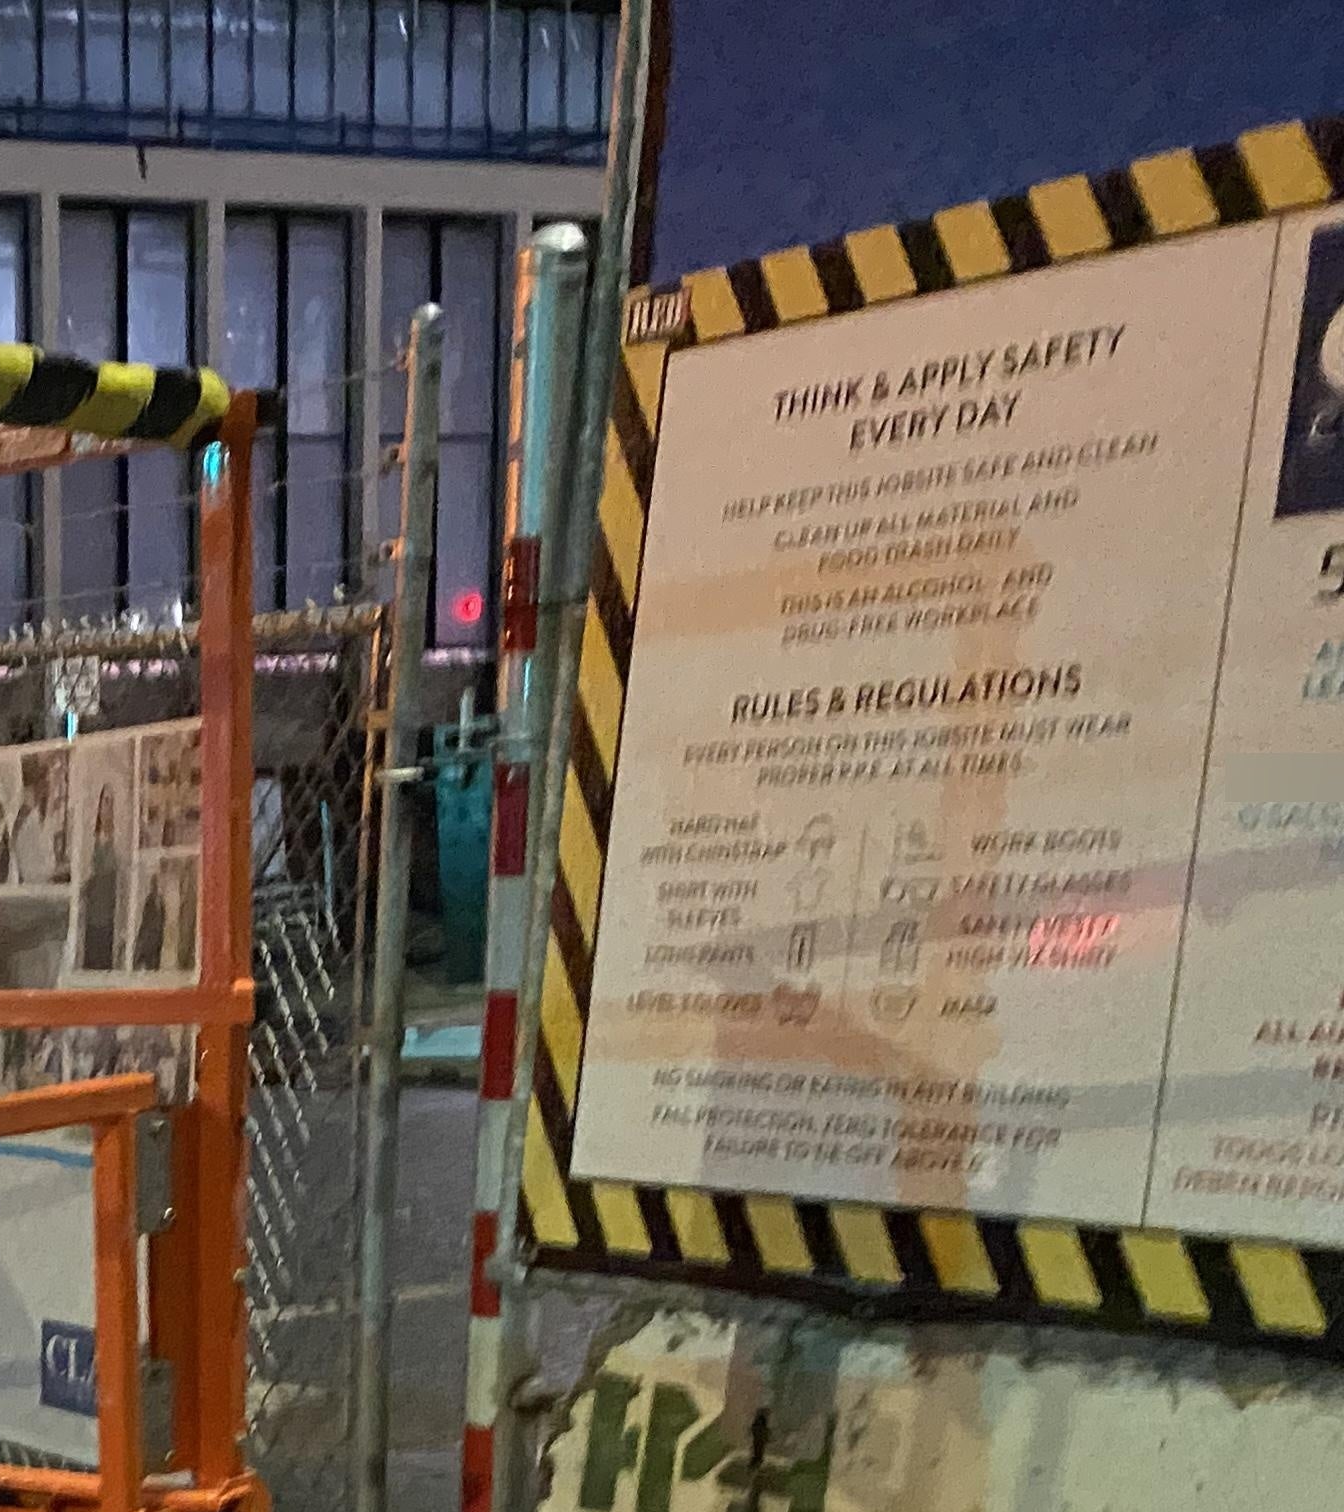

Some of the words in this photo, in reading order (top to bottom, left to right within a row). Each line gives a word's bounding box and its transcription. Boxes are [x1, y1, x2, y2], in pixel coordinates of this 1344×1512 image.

[771, 375, 863, 420] THINK
[871, 370, 891, 402] &
[897, 350, 994, 397] APPLY
[1000, 324, 1126, 378] SAFETY
[849, 403, 949, 452] EVERY
[955, 390, 1022, 434] DAY
[825, 475, 872, 504] THIS
[961, 453, 1014, 484] SAFE
[1020, 443, 1072, 475] AND
[1076, 430, 1160, 466] CLEAN
[915, 495, 1020, 532] MATERIAL
[1026, 486, 1080, 517] AND
[1000, 562, 1056, 591] AND
[730, 686, 821, 725] RULES
[853, 663, 1083, 715] REGULATIONS
[999, 715, 1061, 745] MUST
[1065, 710, 1132, 741] WEAR
[45, 1333, 95, 1385] CL
